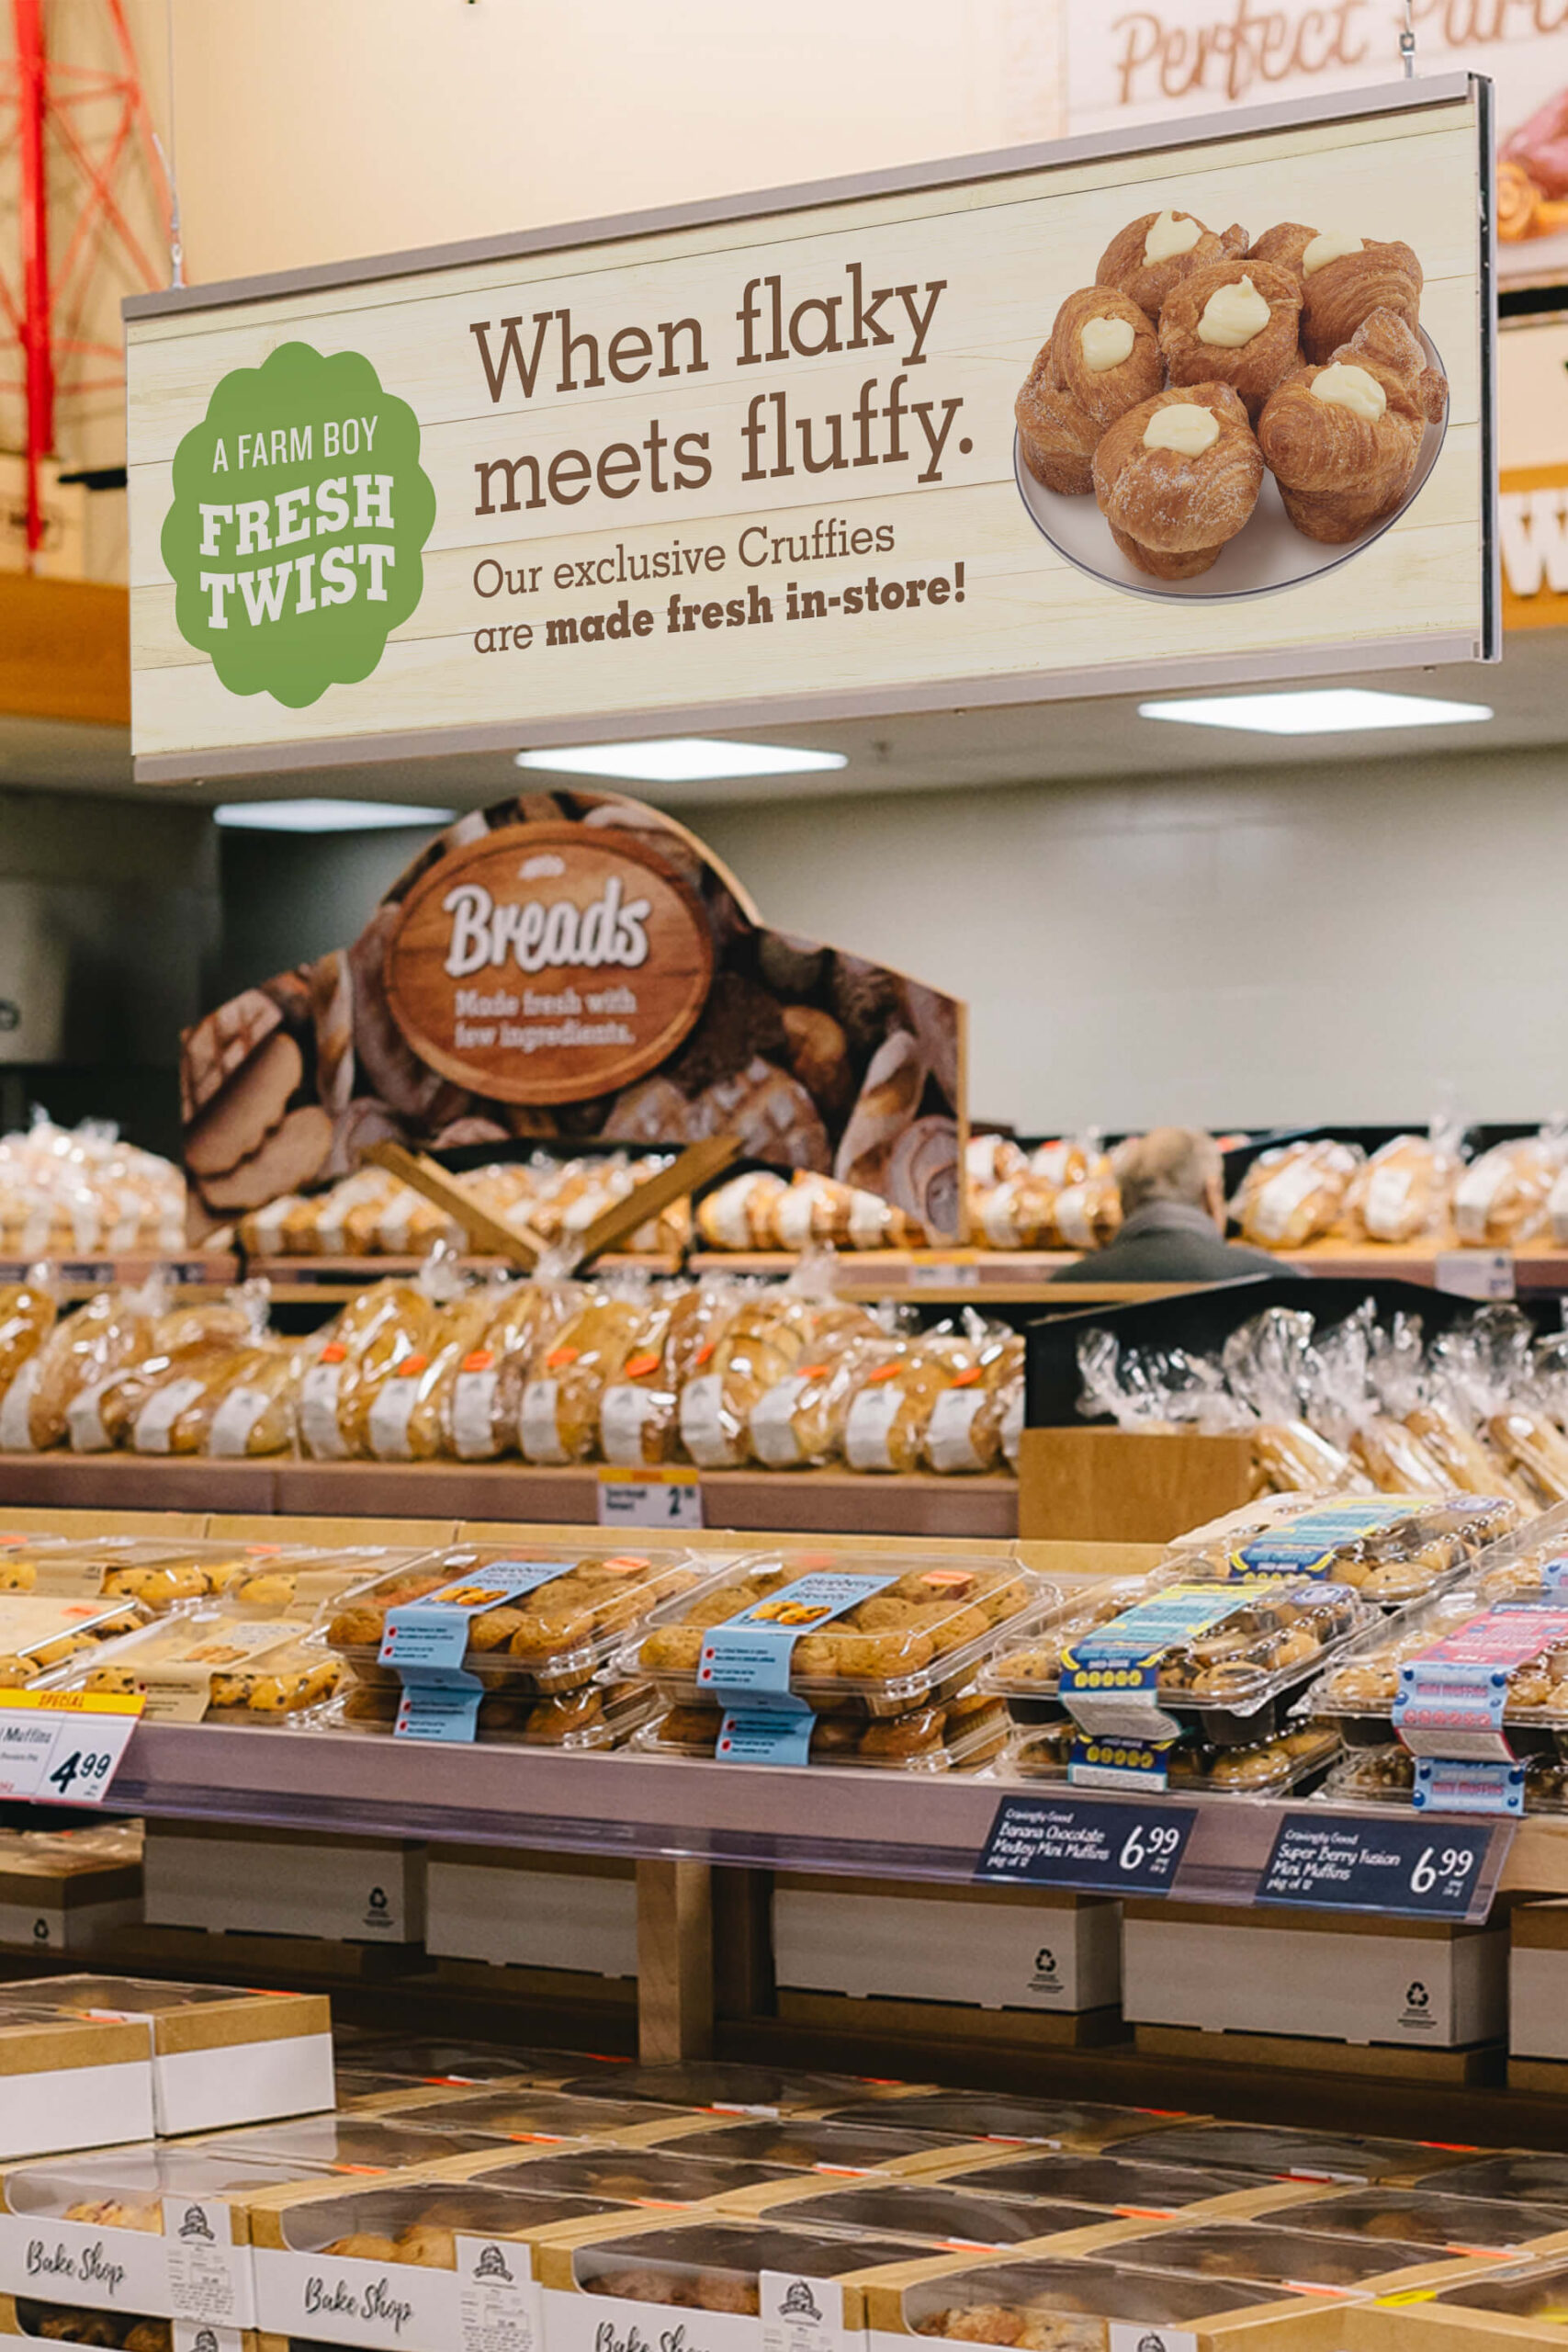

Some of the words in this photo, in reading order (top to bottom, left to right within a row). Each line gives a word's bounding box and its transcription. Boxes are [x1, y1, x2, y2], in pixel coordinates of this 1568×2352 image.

[1112, 0, 1368, 103] Perfect
[469, 308, 708, 403] When
[736, 262, 948, 367] flaky
[213, 438, 229, 473] A
[238, 425, 312, 469] FARM
[323, 415, 378, 458] BOY
[474, 419, 712, 515] meets
[740, 374, 974, 483] fluffy.
[198, 474, 395, 557] FRESH
[199, 544, 396, 629] TWIST
[473, 558, 543, 598] Our
[553, 539, 726, 589] exclusive
[738, 517, 896, 567] Cruffies
[473, 623, 534, 654] are
[546, 600, 654, 646] made
[667, 584, 773, 633] fresh
[786, 561, 966, 621] in-store!
[442, 876, 651, 978] Breads
[39, 1693, 85, 1708] SPECIAL
[998, 1822, 1044, 1838] Banana
[1046, 1825, 1106, 1843] Chocolate
[1037, 1841, 1064, 1858] Mini
[1065, 1844, 1110, 1861] Muffins
[1278, 1843, 1316, 1862] Super
[1317, 1847, 1359, 1866] Berry
[1359, 1848, 1401, 1866] Fusion
[1271, 1860, 1300, 1877] Mini
[1303, 1862, 1351, 1881] Muffins
[27, 2239, 75, 2276] Bake
[78, 2242, 125, 2295] Shop
[304, 2277, 356, 2313] Bake
[359, 2278, 413, 2335] Shop
